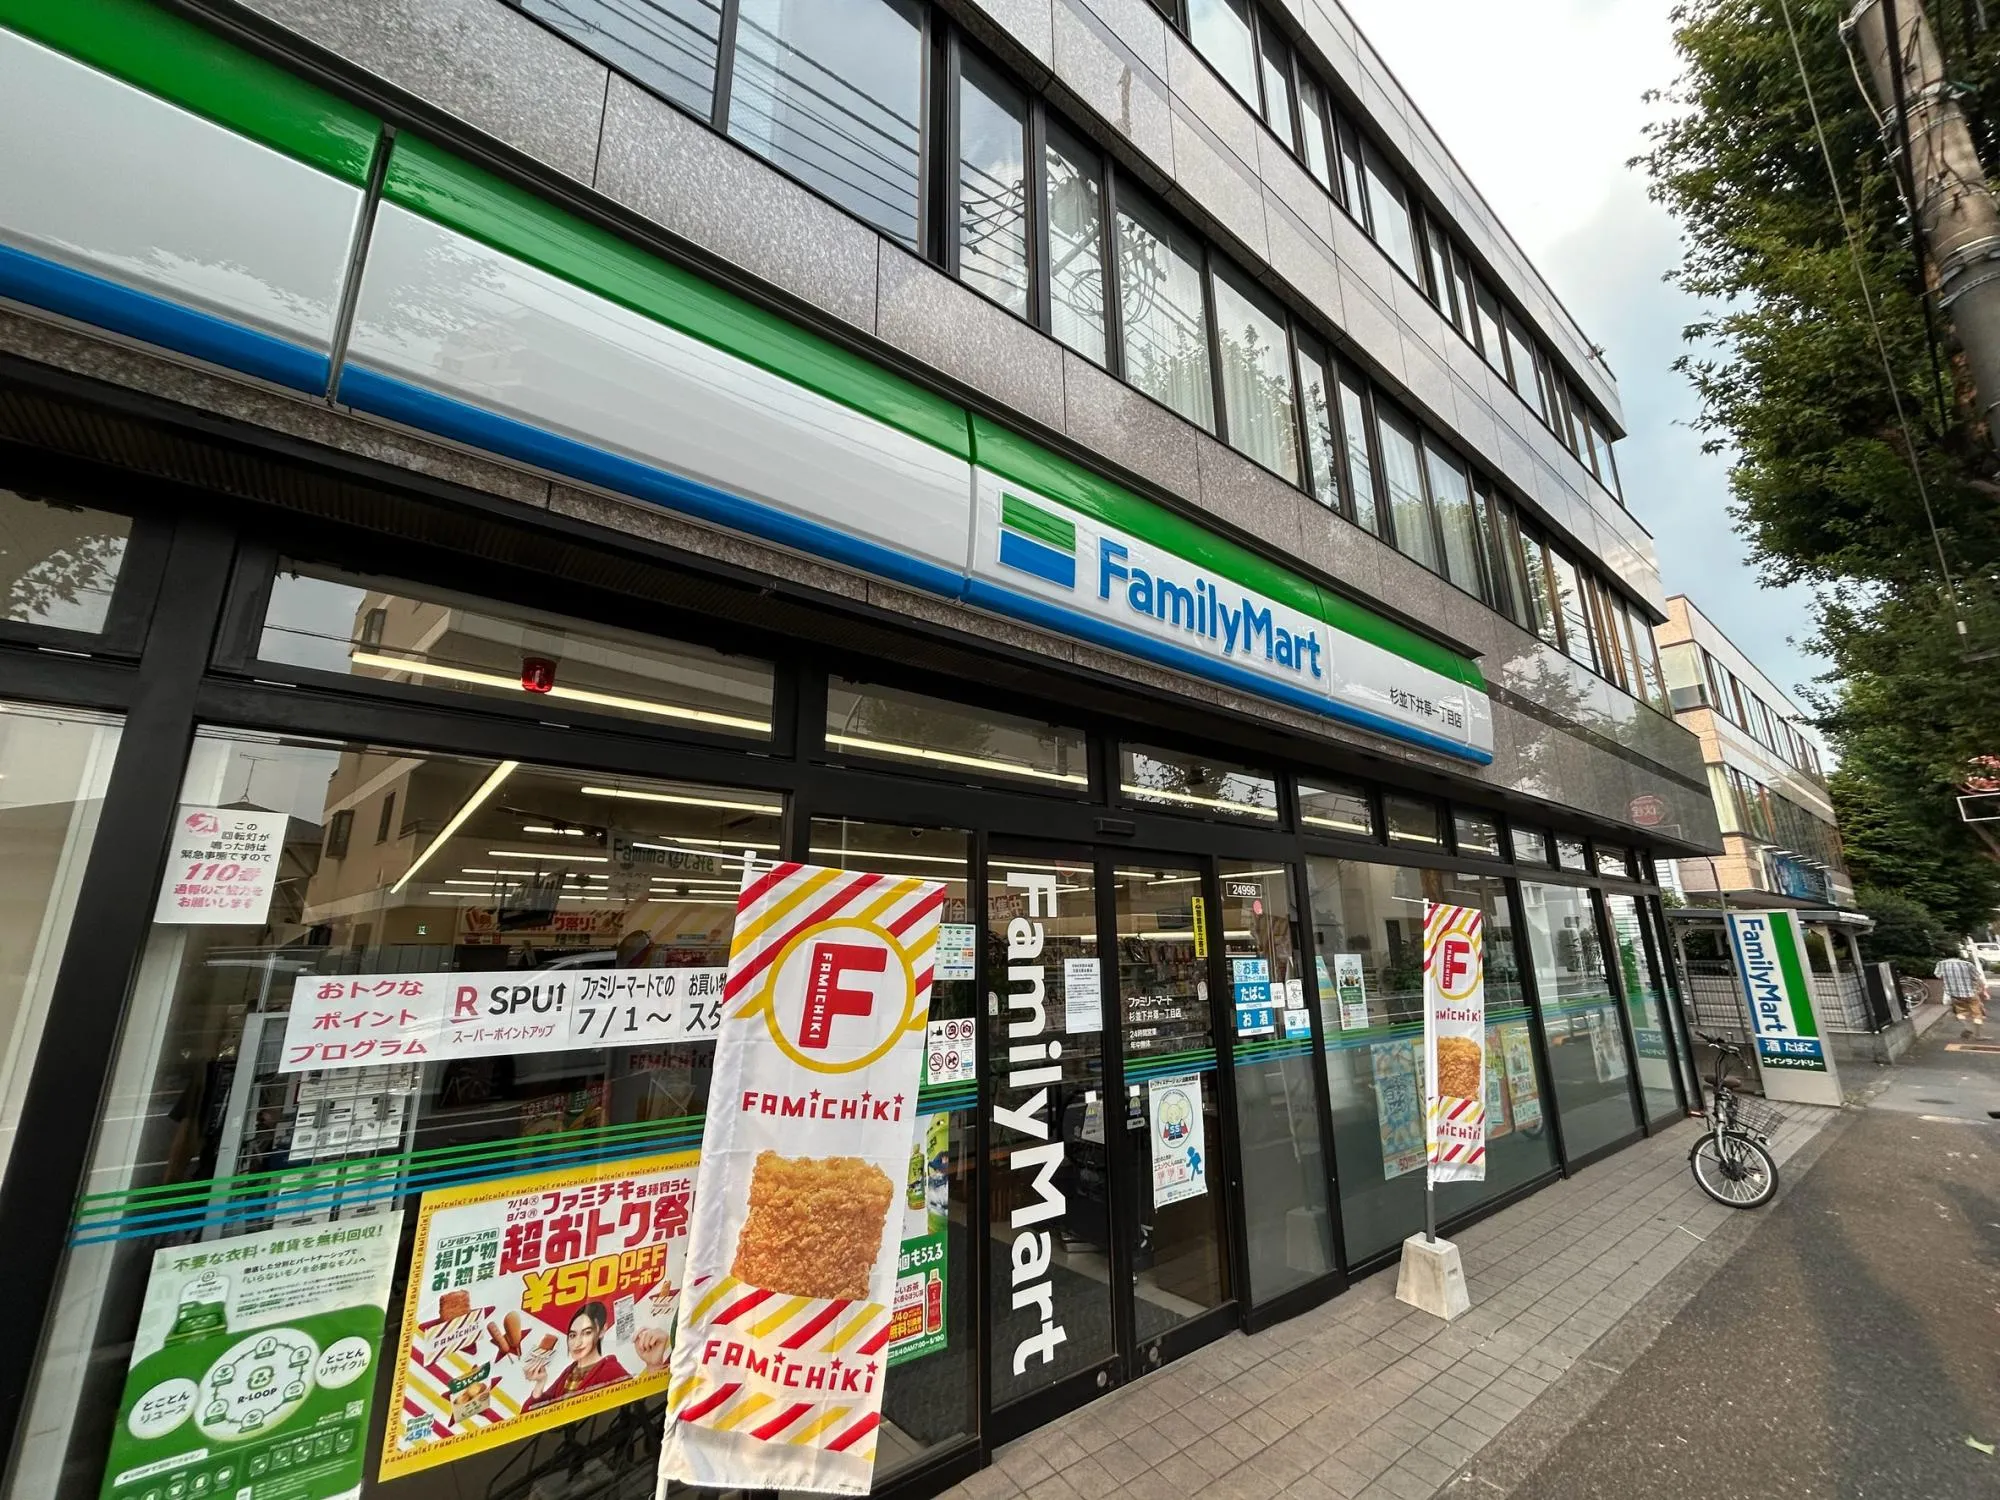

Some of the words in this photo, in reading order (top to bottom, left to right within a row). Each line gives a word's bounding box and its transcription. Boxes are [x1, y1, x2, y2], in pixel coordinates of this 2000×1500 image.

[1098, 536, 1321, 679] FamilyMart
[1389, 686, 1462, 729] 杉並下井草一丁目店
[221, 831, 270, 842] 回転灯が
[234, 822, 258, 831] この
[180, 849, 271, 862] 緊急事態ですので
[210, 841, 268, 852] 鳴った時は
[1232, 884, 1256, 896] 24998
[1443, 940, 1470, 989] F
[1739, 918, 1788, 1032] FamilyMart
[316, 979, 425, 1000] おトクな
[581, 973, 676, 1000] ファミリーマートでの
[799, 942, 888, 1049] F
[809, 952, 833, 1039] FAMICHIKI
[1240, 985, 1266, 1002] たばこ
[453, 986, 479, 1018] R
[1127, 995, 1173, 1008] ファミリーマート
[312, 1008, 418, 1030] ポイント
[1242, 1010, 1268, 1028] お酒
[452, 1024, 556, 1044] スーパーポイントアップ
[289, 1039, 428, 1064] プログラム
[1783, 1041, 1816, 1054] たばこ
[1763, 1056, 1823, 1067] コインランドリー
[994, 872, 1067, 1376] FamilyMart
[499, 1192, 696, 1276] 超おトク祭
[434, 1241, 498, 1271] 揚げ物
[619, 1242, 668, 1271] OFF
[432, 1261, 496, 1292] お惣菜
[619, 1262, 666, 1291] クーポン
[319, 1357, 368, 1377] リサイクル
[326, 1348, 365, 1365] とことん
[142, 1390, 190, 1413] とことん
[237, 1387, 278, 1405] R-LOOP
[140, 1403, 187, 1424] リユース
